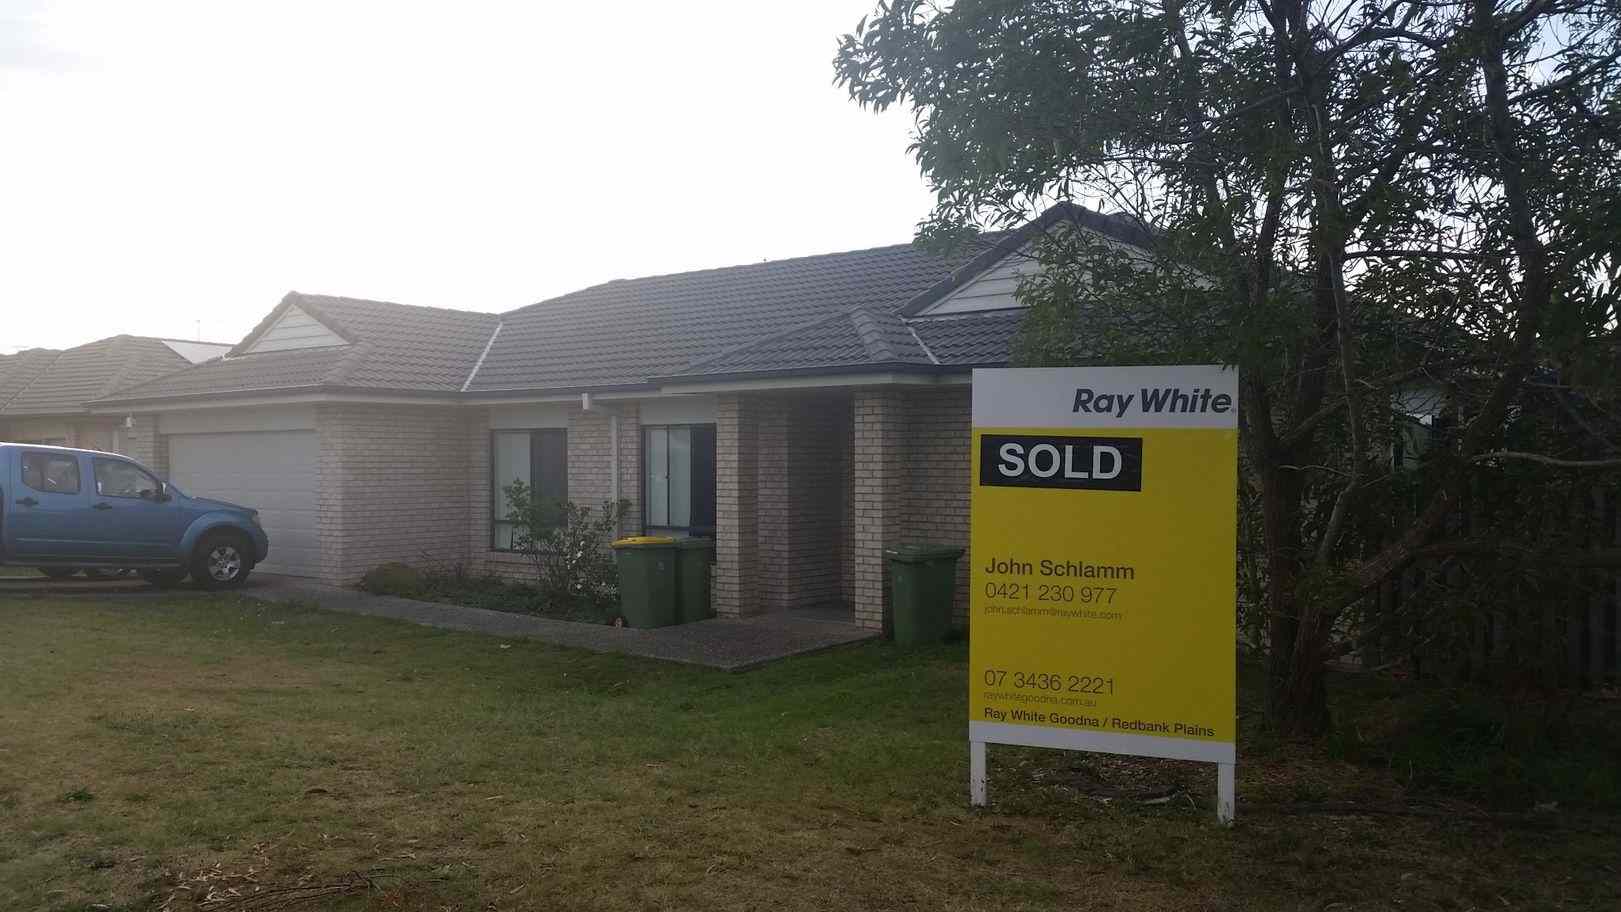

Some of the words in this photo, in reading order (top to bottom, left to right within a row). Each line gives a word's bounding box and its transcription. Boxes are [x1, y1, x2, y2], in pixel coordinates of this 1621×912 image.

[1072, 388, 1134, 418] Ray
[1141, 388, 1232, 413] White
[998, 442, 1122, 480] SOLD
[985, 558, 1033, 576] John
[1039, 559, 1135, 580] Schlamm
[985, 582, 1030, 600] 0421
[1038, 584, 1074, 602] 230
[1080, 586, 1117, 604] 977
[984, 669, 1007, 687] 07
[1014, 672, 1062, 692] 3436
[1068, 675, 1115, 695] 2221
[984, 707, 1007, 721] Ray
[1011, 709, 1046, 723] White
[1050, 712, 1099, 728] Goodna
[1112, 717, 1169, 733] Redbank
[1174, 722, 1215, 738] Plains
